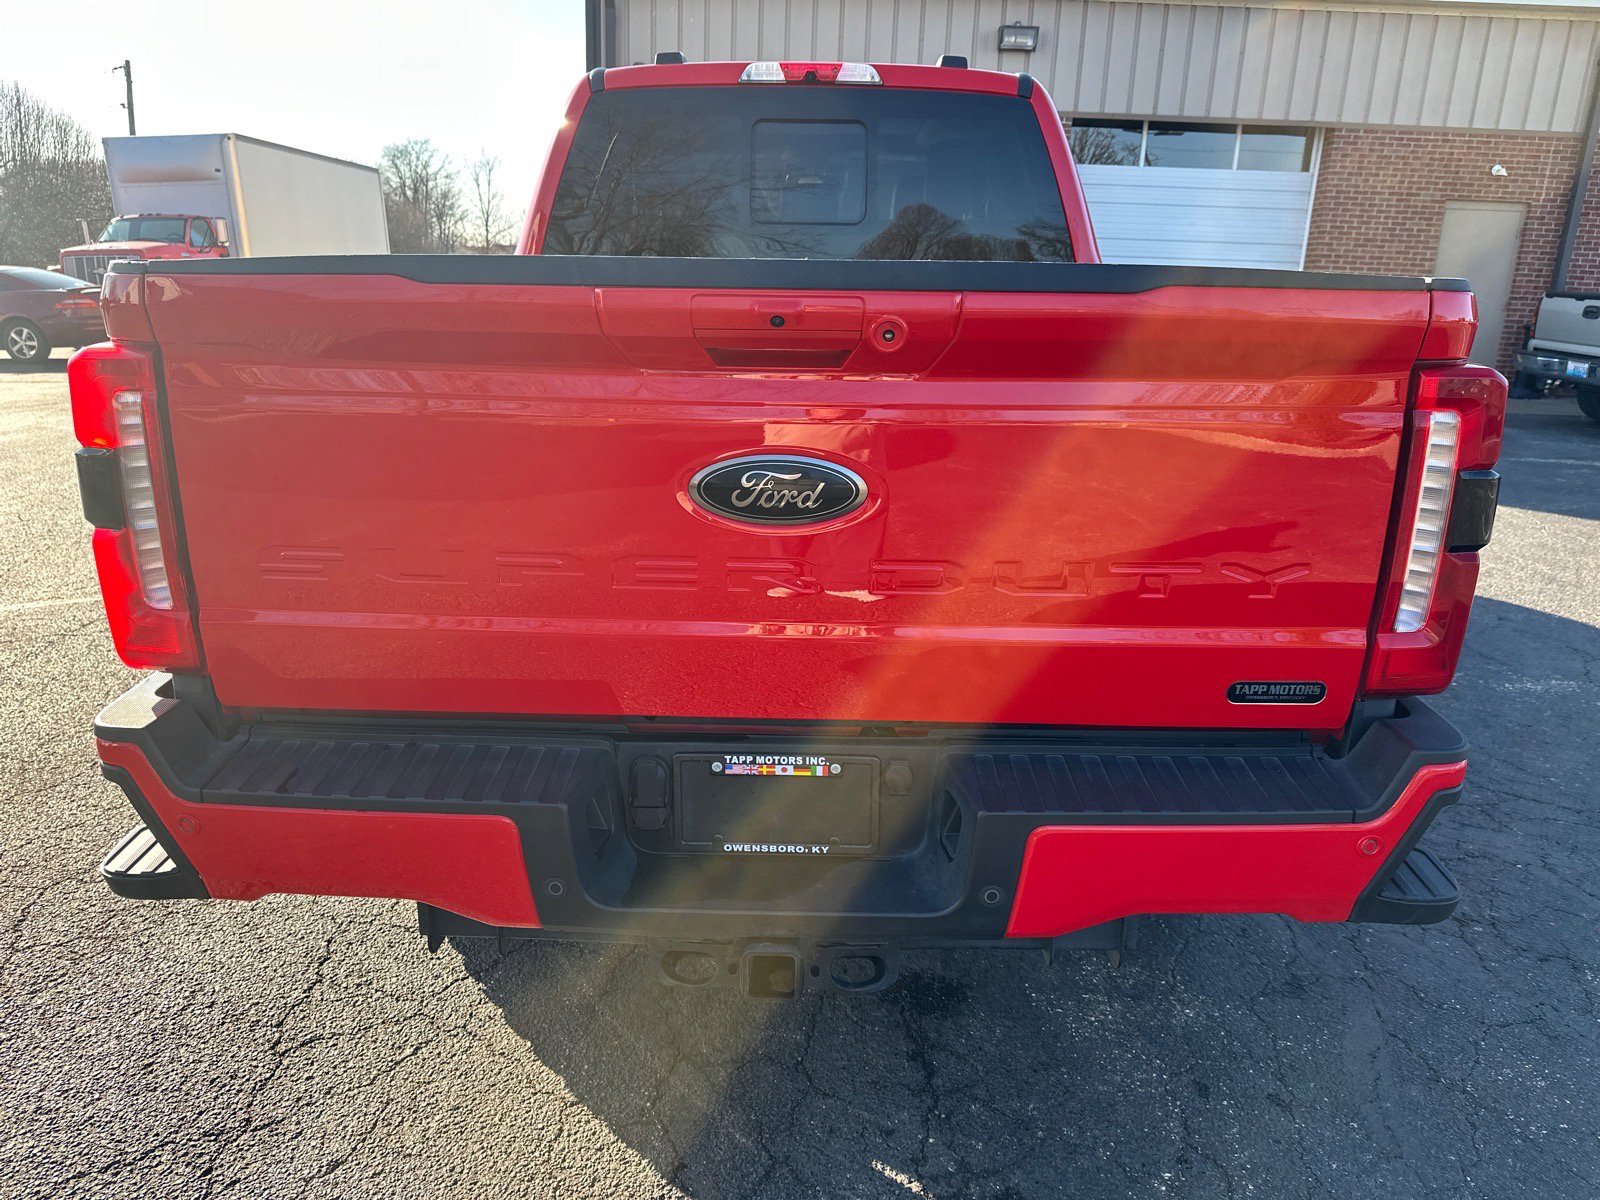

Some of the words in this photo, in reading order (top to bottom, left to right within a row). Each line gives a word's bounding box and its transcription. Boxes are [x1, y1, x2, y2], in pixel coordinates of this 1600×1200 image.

[731, 470, 826, 509] Ford
[868, 559, 1312, 600] DUTY
[1234, 684, 1267, 695] TAPP
[1268, 684, 1321, 695] MOTORS
[724, 755, 753, 764] TAPP
[755, 755, 803, 765] MOTORS
[805, 756, 830, 765] INC.
[723, 844, 809, 854] OWENSBORO,
[811, 845, 829, 854] KY
